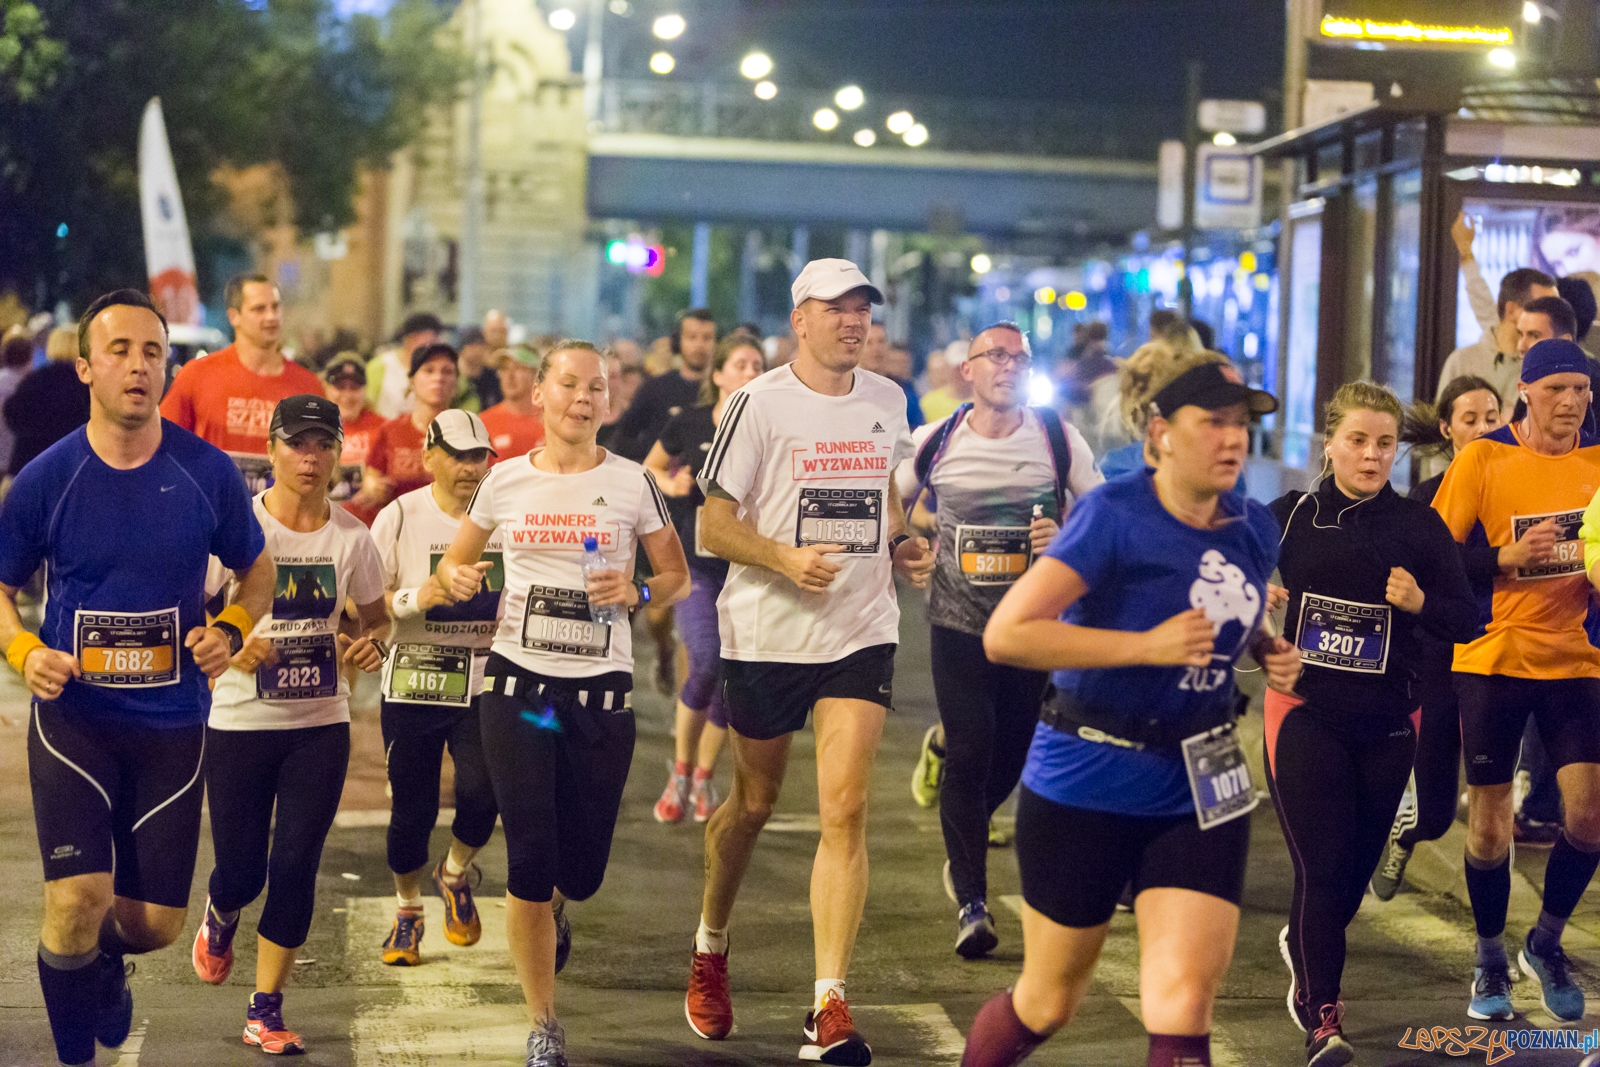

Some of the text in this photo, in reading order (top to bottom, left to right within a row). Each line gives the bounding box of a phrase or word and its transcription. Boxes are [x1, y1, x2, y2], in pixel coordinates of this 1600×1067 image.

[802, 457, 888, 473] WYZWANIE
[816, 519, 866, 541] 11535
[976, 555, 1011, 572] 5211
[425, 623, 496, 636] GRUDZIĄDZ
[541, 618, 594, 643] 11369
[1318, 630, 1365, 657] 3207
[101, 649, 154, 671] 7682
[277, 665, 321, 688] 2823
[408, 671, 447, 691] 4167
